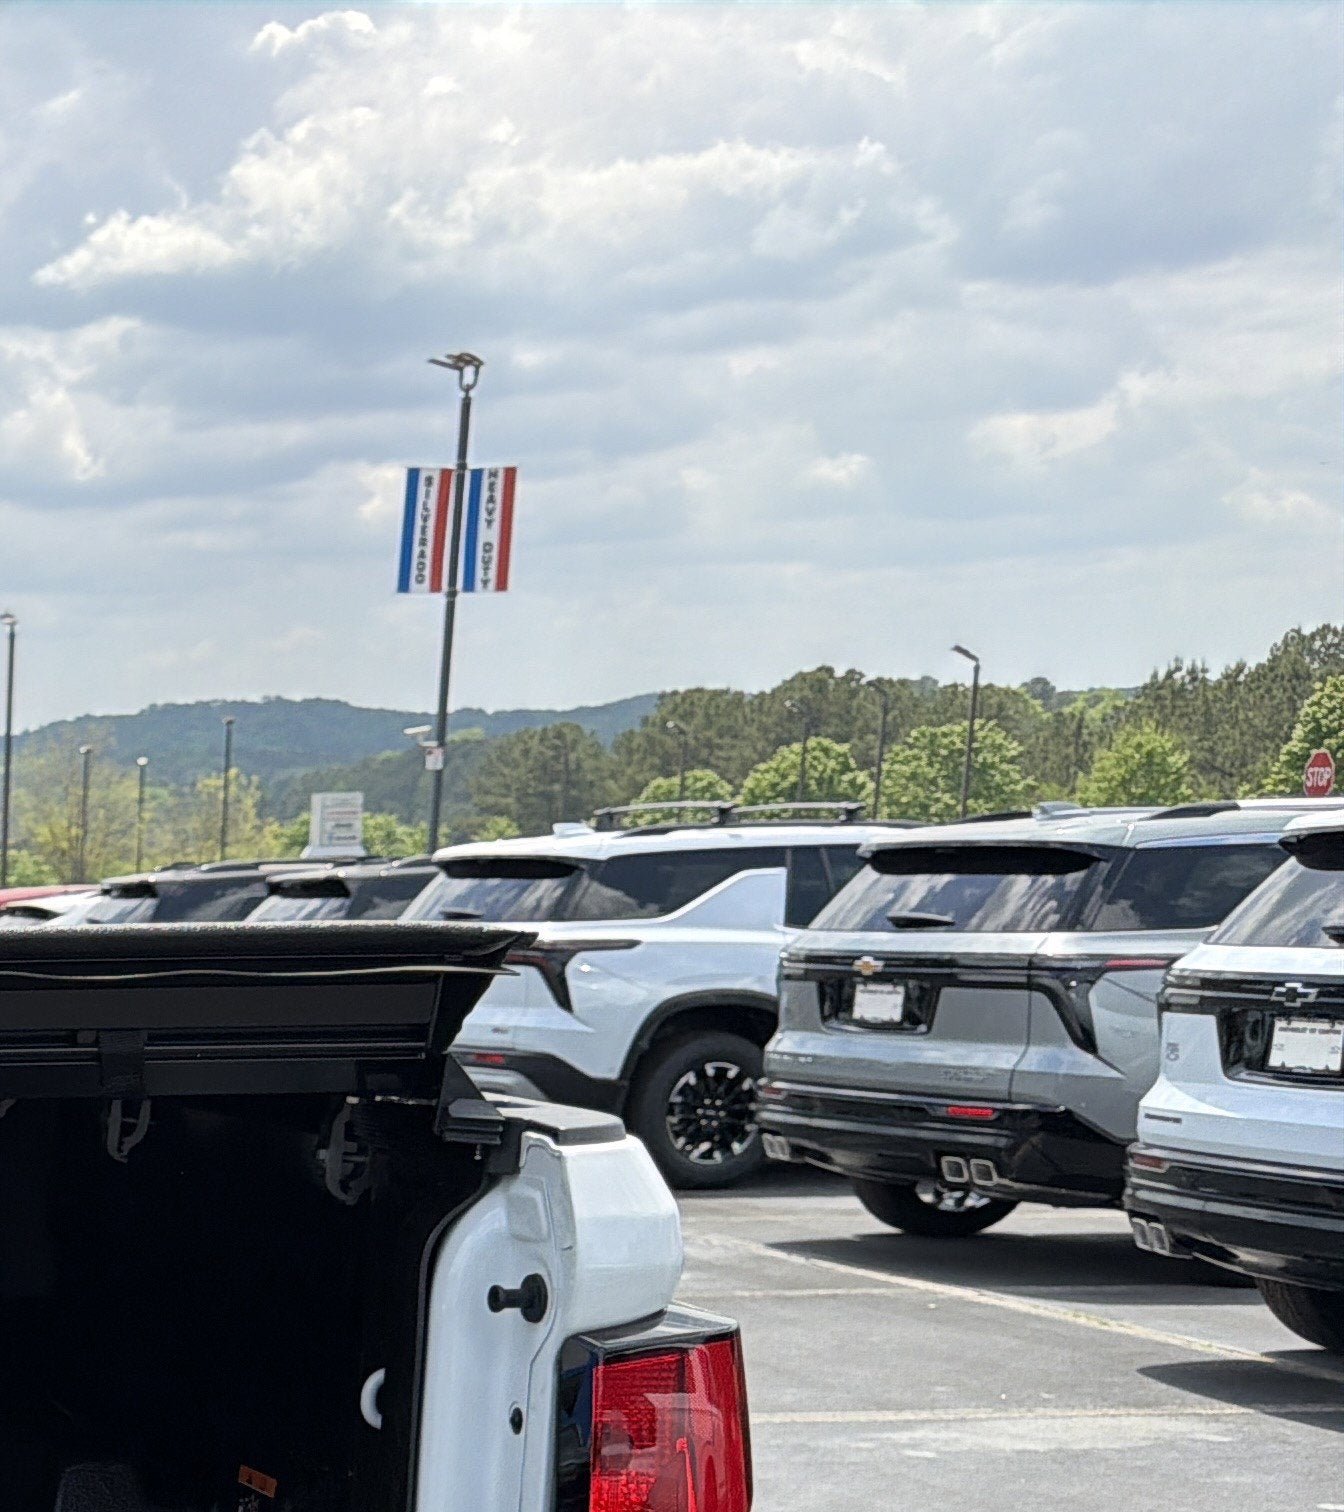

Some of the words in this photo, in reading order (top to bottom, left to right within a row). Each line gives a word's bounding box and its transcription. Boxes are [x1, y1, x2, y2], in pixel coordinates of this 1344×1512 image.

[415, 475, 434, 584] SILVERADO
[481, 541, 494, 589] DUTY
[1306, 766, 1332, 787] STOP
